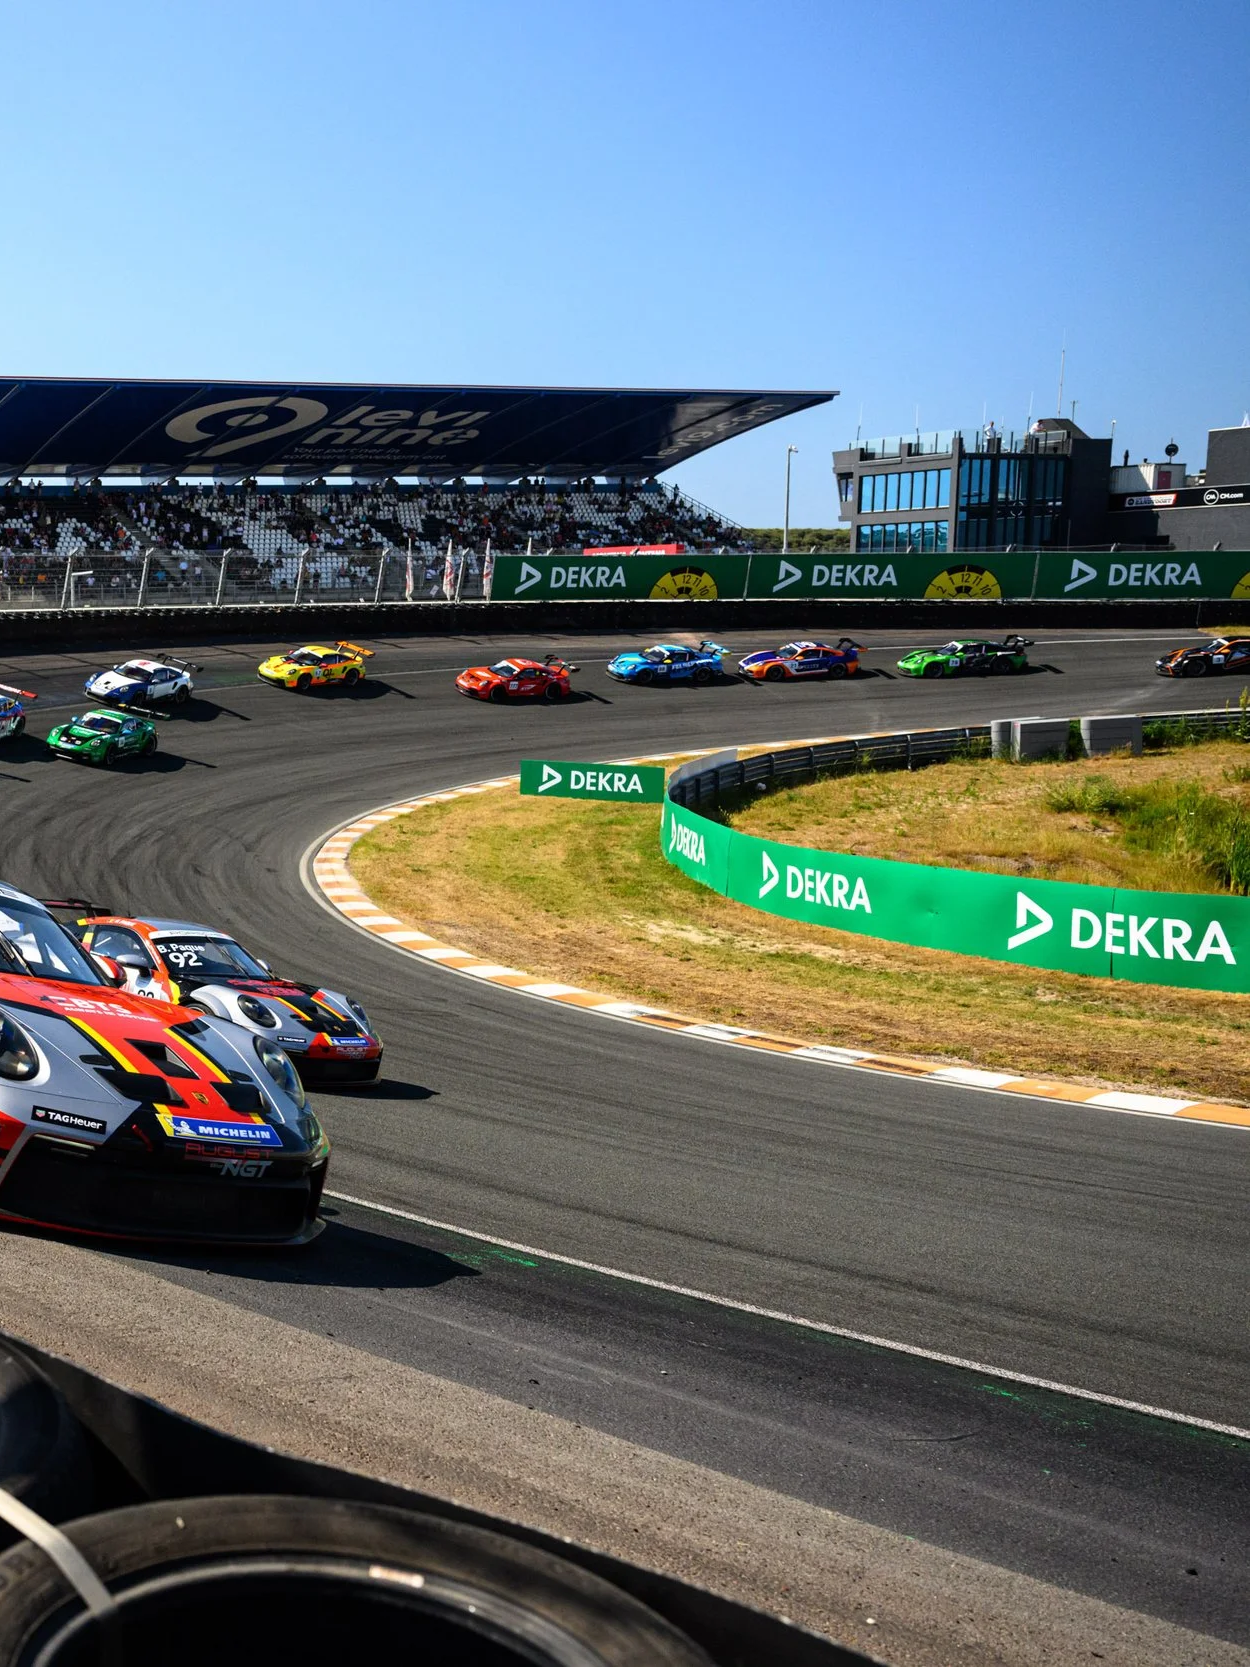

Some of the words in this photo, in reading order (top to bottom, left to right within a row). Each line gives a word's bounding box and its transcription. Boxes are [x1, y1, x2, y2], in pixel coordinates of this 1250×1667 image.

[330, 405, 491, 428] levi
[300, 427, 481, 446] nine
[642, 403, 784, 459] levi9.com
[550, 566, 627, 588] DEKRA
[682, 575, 692, 584] 12
[811, 564, 898, 587] DEKRA
[936, 586, 947, 594] 2
[961, 573, 971, 583] 12
[972, 575, 983, 587] 11
[980, 584, 992, 596] 10
[1108, 562, 1202, 586] DEKRA
[570, 770, 643, 794] DEKRA
[676, 823, 706, 865] DEKRA
[786, 865, 872, 914] DEKRA
[1070, 908, 1237, 965] DEKRA
[157, 944, 170, 954] B.
[168, 951, 203, 969] 92
[47, 1110, 103, 1130] TAGHeuer
[197, 1125, 271, 1139] MICHELIN
[185, 1142, 275, 1160] AUGUST
[219, 1158, 274, 1178] NGT
